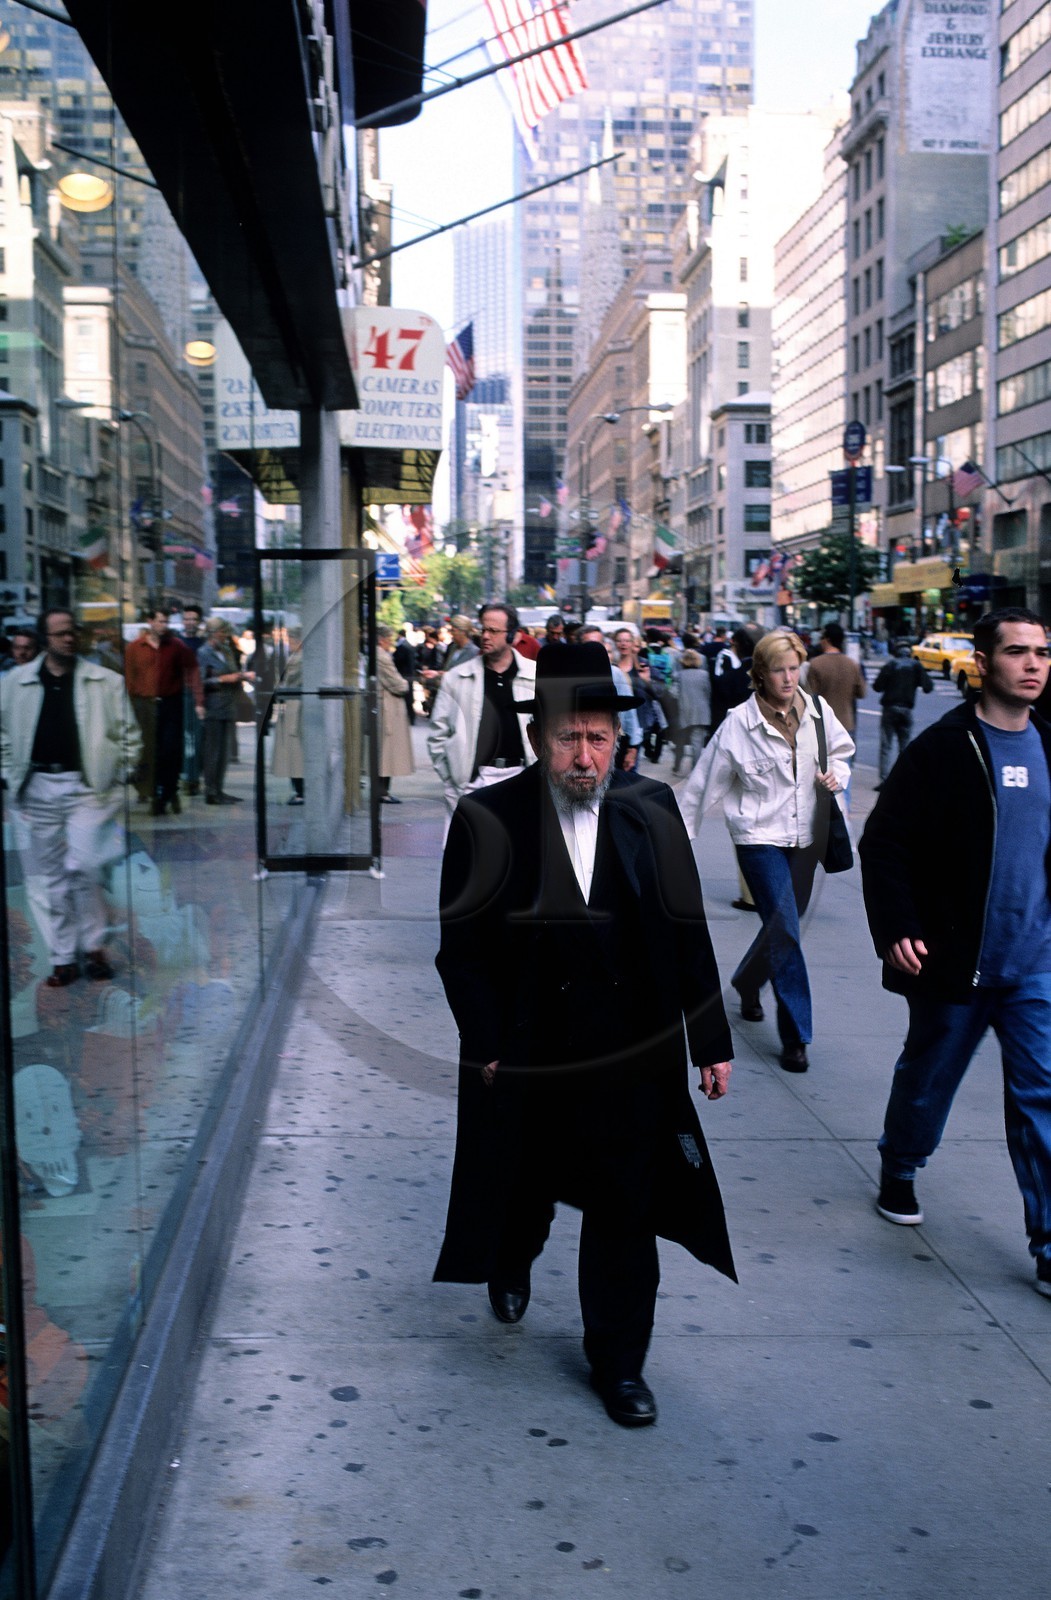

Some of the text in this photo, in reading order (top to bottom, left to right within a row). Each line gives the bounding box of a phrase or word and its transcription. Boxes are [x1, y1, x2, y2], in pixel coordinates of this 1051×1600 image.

[924, 2, 987, 15] DIAMOND
[945, 17, 956, 31] &
[926, 32, 985, 46] JEWELRY
[921, 46, 989, 60] EXCHANGE
[362, 376, 441, 395] CAMERAS
[355, 422, 442, 441] ELECTRONICS
